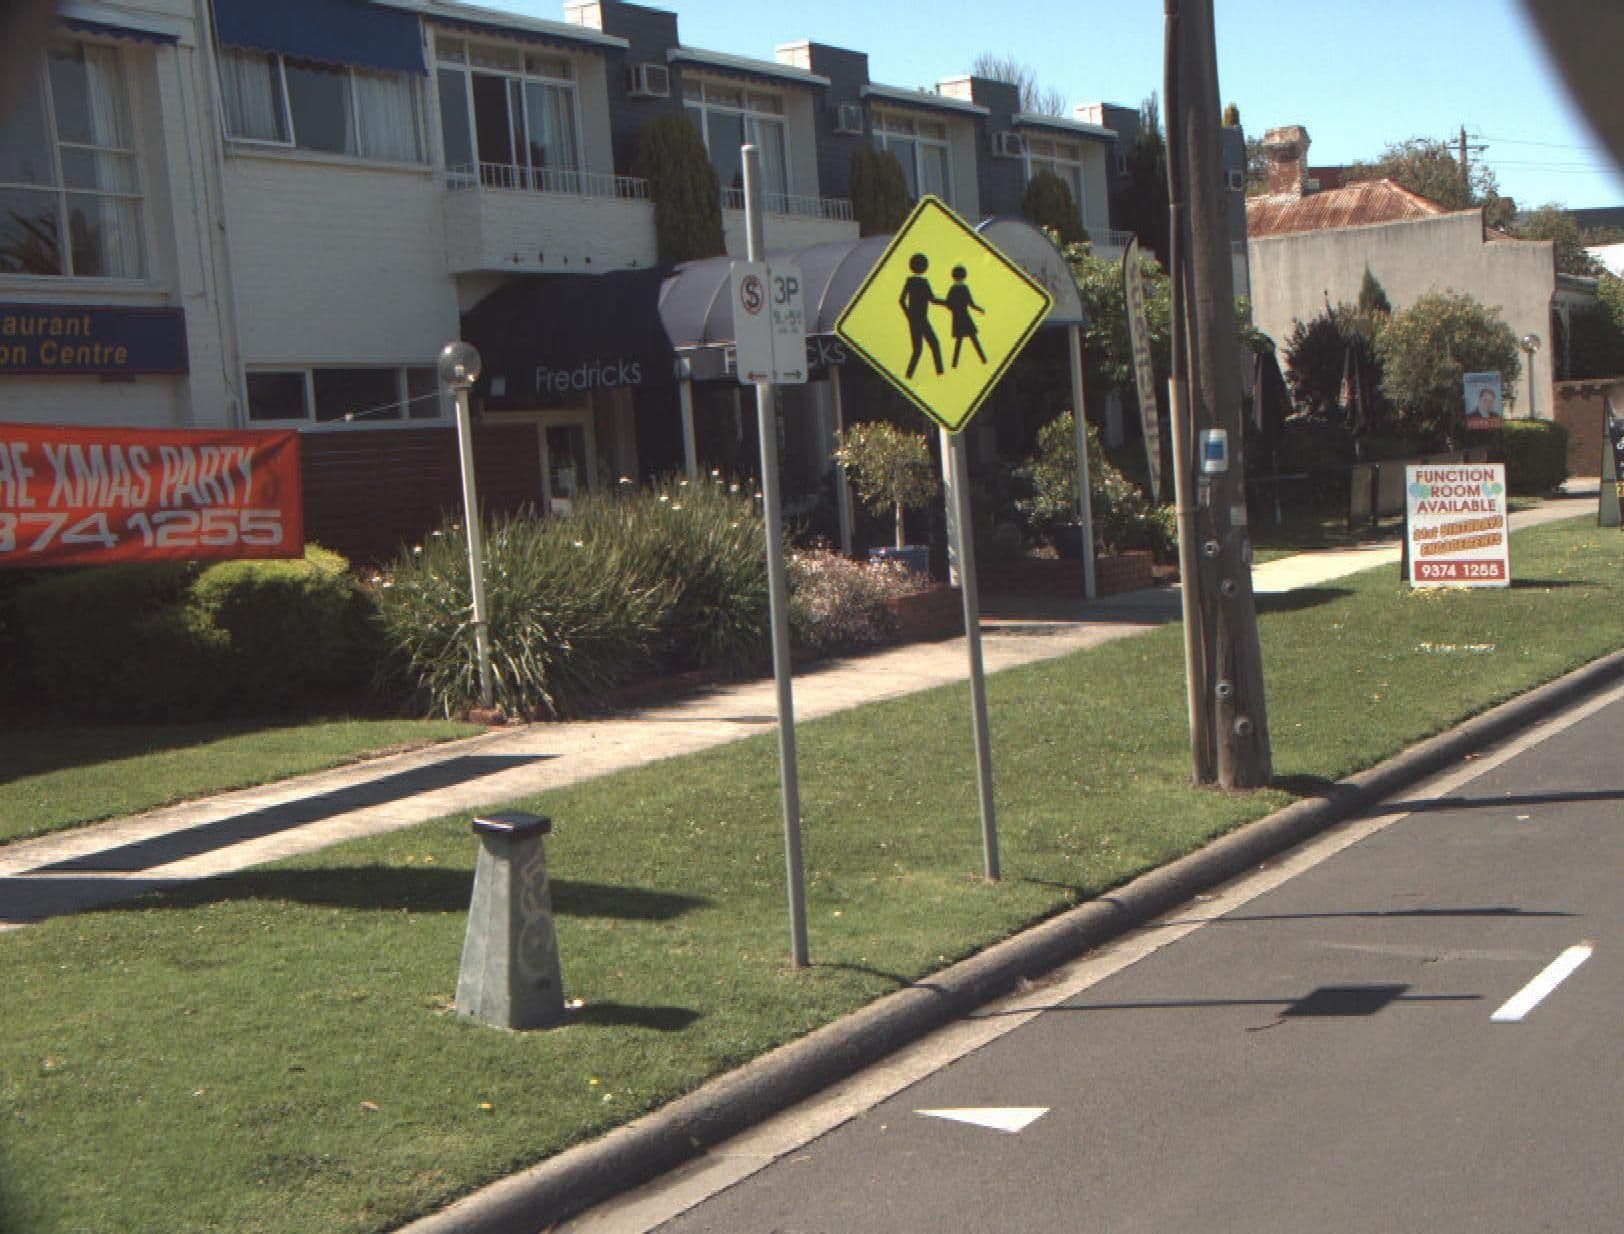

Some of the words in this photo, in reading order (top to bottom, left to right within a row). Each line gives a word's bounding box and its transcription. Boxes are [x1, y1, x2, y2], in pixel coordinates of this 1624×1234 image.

[773, 276, 799, 304] 3P
[38, 340, 129, 365] Centre
[535, 358, 641, 393] Fredricks
[43, 443, 151, 509] XMAS
[158, 446, 255, 506] PARTY
[1415, 469, 1495, 482] FUNCTION
[1430, 485, 1481, 498] ROOM
[1417, 499, 1496, 513] AVAILABLE
[127, 508, 284, 549] 1255
[1421, 564, 1456, 577] 9374
